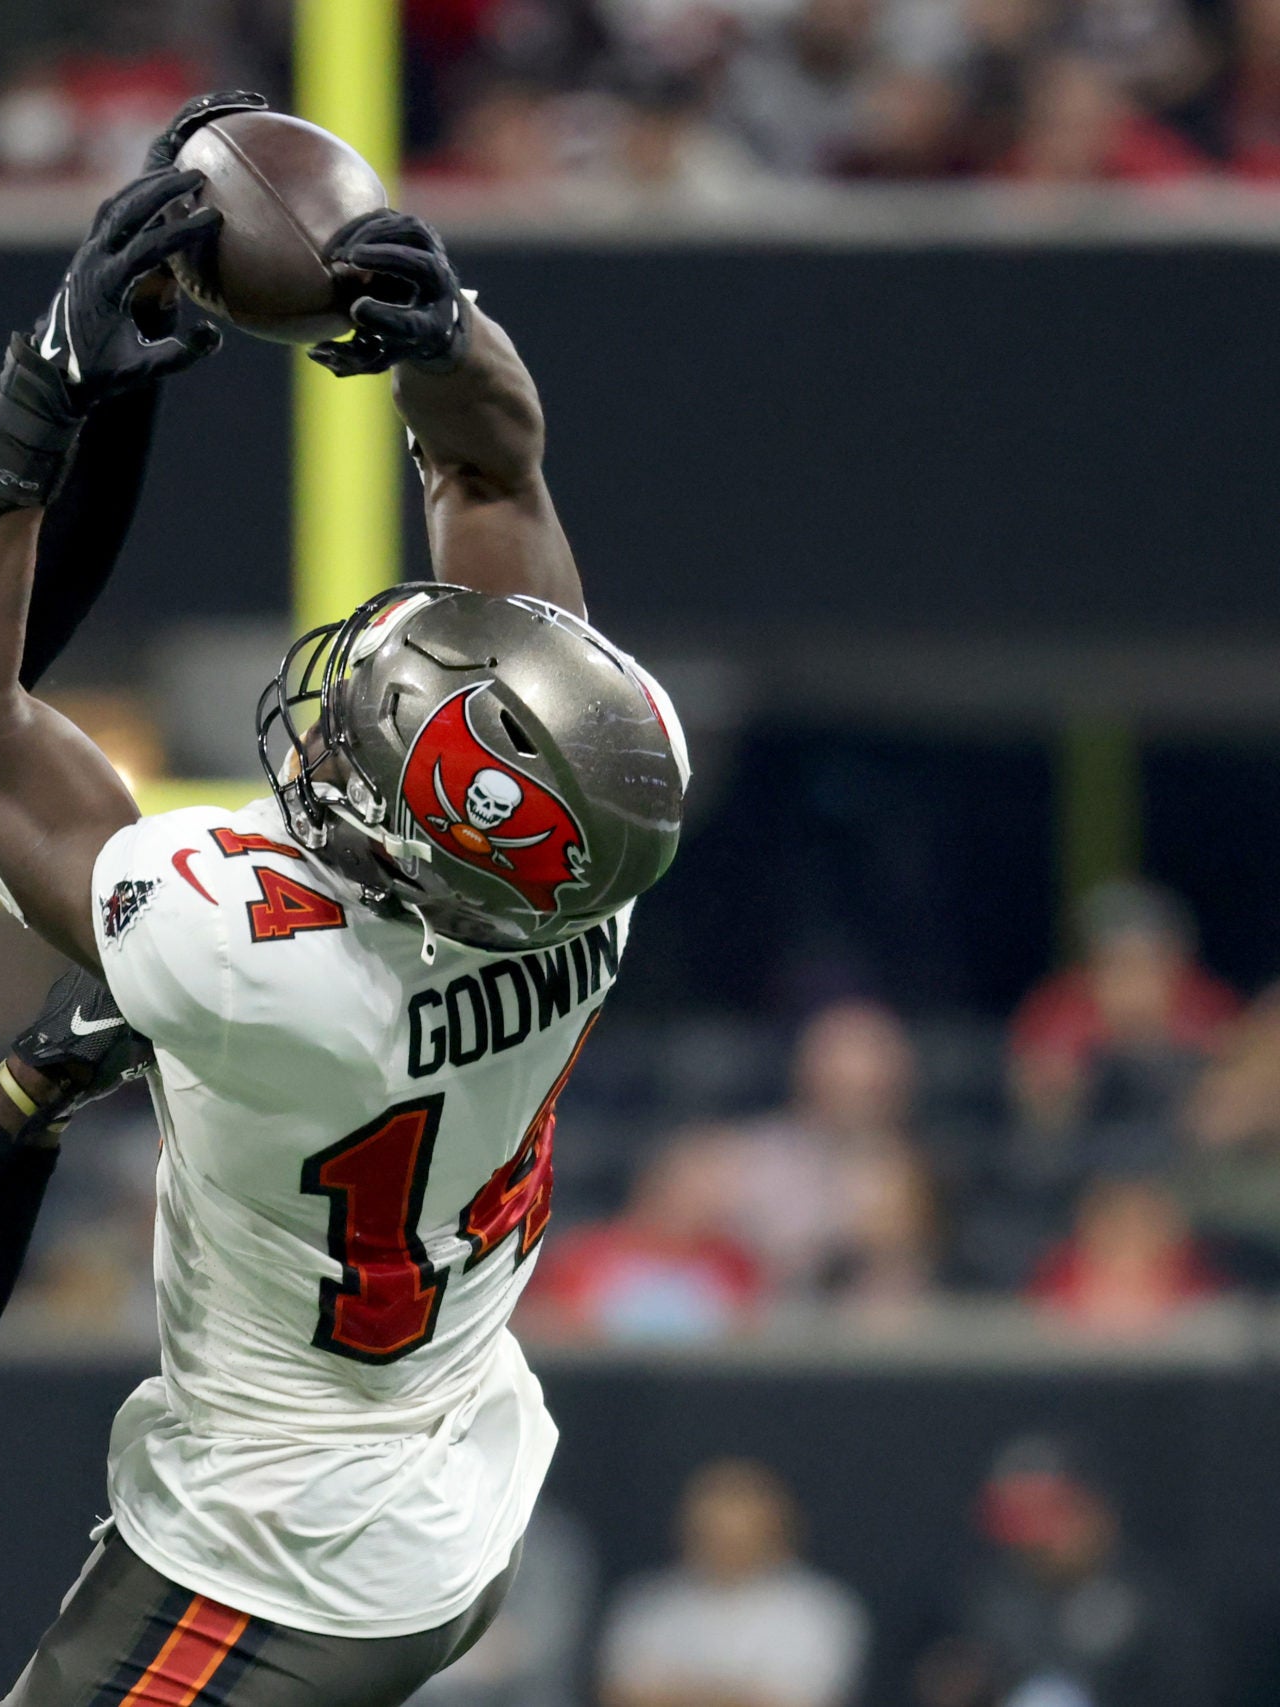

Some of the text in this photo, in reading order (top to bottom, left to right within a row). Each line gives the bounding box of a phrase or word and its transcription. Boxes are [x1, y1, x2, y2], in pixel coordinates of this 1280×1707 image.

[207, 827, 348, 943] 14
[408, 916, 619, 1079] GODWIN
[300, 1092, 556, 1366] 14
